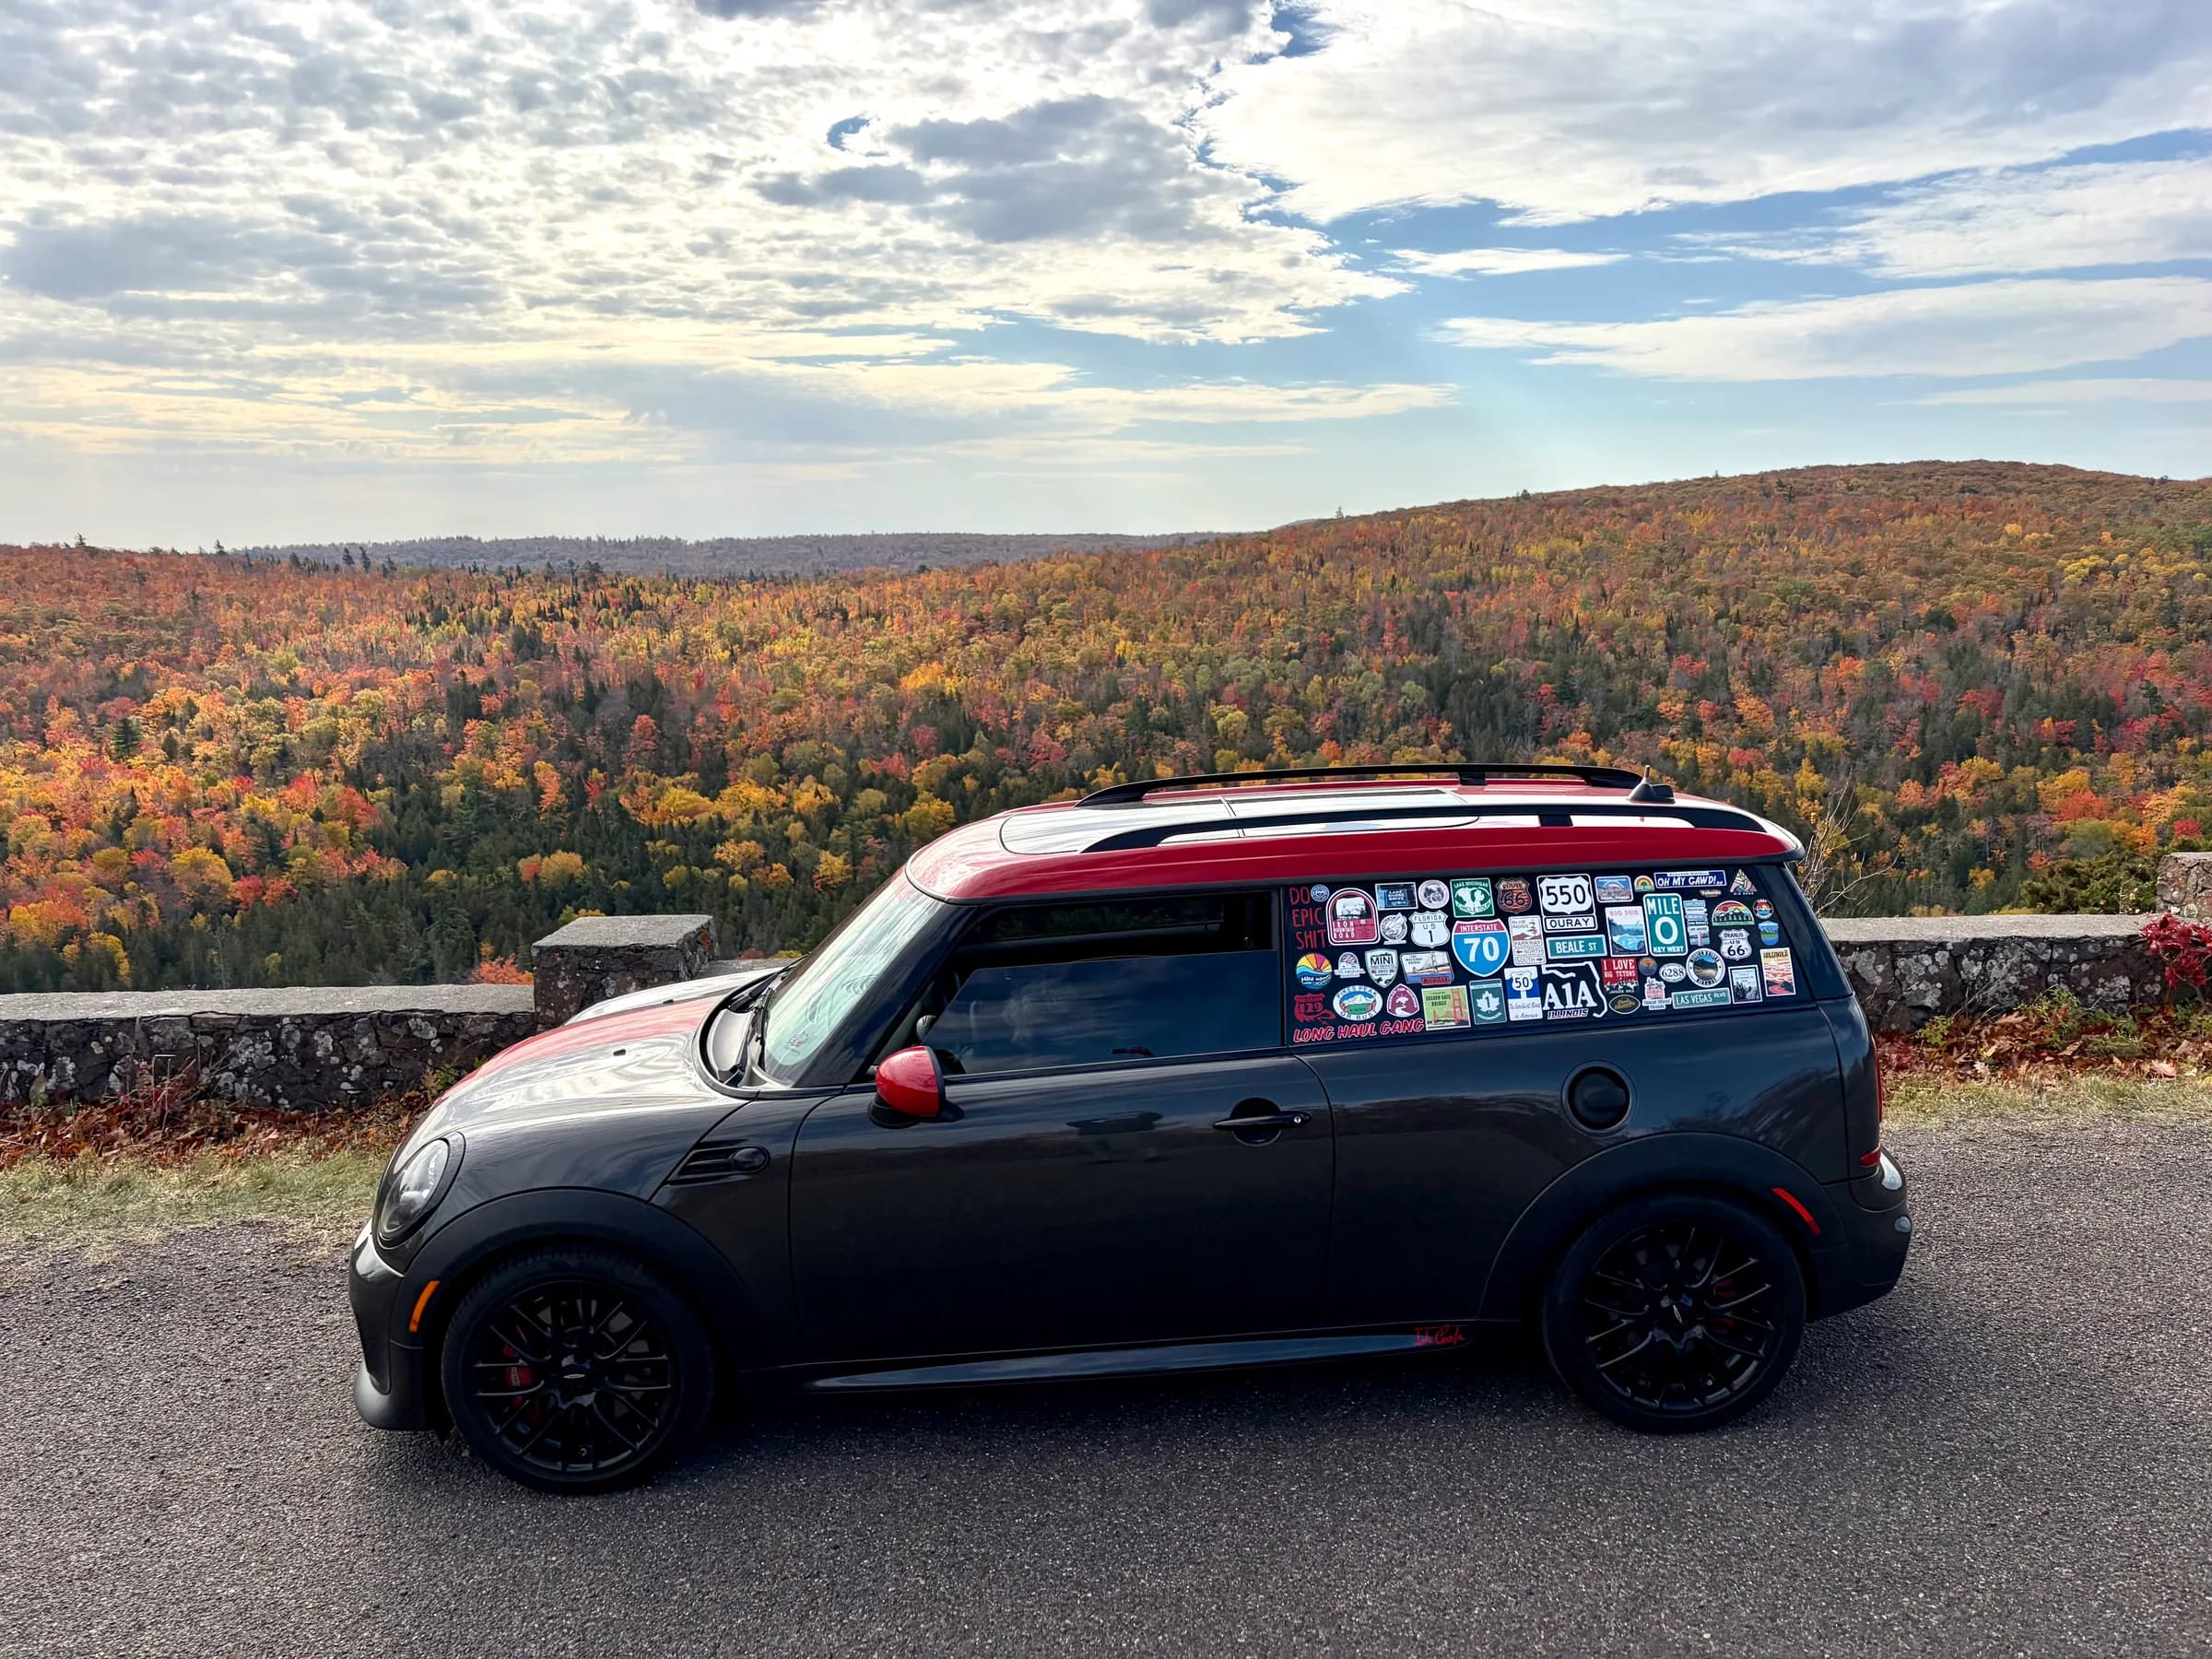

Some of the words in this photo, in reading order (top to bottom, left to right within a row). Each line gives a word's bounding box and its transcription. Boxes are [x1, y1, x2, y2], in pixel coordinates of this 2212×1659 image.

[1657, 877, 1670, 886] OH
[1672, 877, 1686, 885] MY
[1289, 887, 1311, 905] DO
[1503, 891, 1526, 906] 66
[1546, 884, 1586, 906] 550
[1646, 897, 1680, 915] MILE
[1292, 907, 1326, 927] EPIC
[1549, 917, 1590, 928] OURAY
[1460, 924, 1499, 932] INTERSTATE
[1296, 929, 1326, 950] SHIT
[1429, 930, 1434, 943] 1
[1464, 935, 1500, 962] 70
[1555, 940, 1585, 954] BEALE
[1588, 942, 1597, 951] ST
[1727, 945, 1746, 957] 66
[1370, 956, 1394, 966] MINI
[1604, 960, 1607, 971] I
[1612, 959, 1636, 970] LOVE
[1615, 970, 1636, 978] TETONS
[1661, 967, 1685, 978] 6288
[1514, 977, 1530, 989] 50
[1484, 996, 1490, 1008] 1
[1542, 981, 1598, 1011] A1A
[1676, 995, 1689, 1006] LAS
[1690, 993, 1712, 1004] VEGAS
[1547, 1008, 1589, 1019] ILLINOIS
[1293, 1026, 1335, 1042] LONG
[1337, 1022, 1377, 1039] HAUL
[1379, 1018, 1425, 1035] GANG
